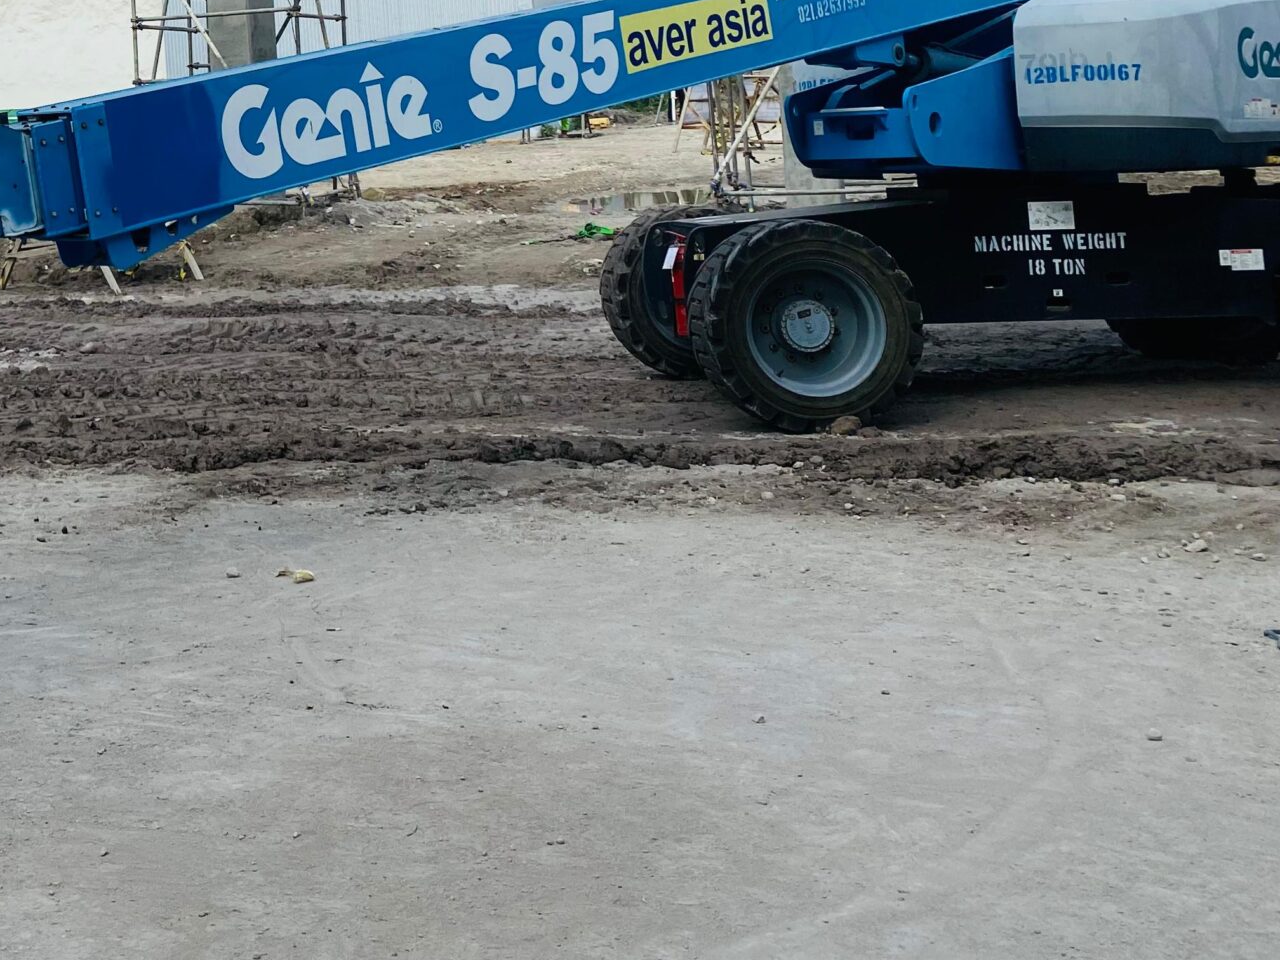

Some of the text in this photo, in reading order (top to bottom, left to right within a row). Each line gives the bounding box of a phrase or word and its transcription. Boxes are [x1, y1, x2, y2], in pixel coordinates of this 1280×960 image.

[626, 16, 697, 68] aver
[468, 9, 620, 122] S-85
[1026, 63, 1142, 84] 12BLF00167
[974, 232, 1127, 252] MACHINE WEIGHT
[1028, 258, 1086, 276] 18 TON
